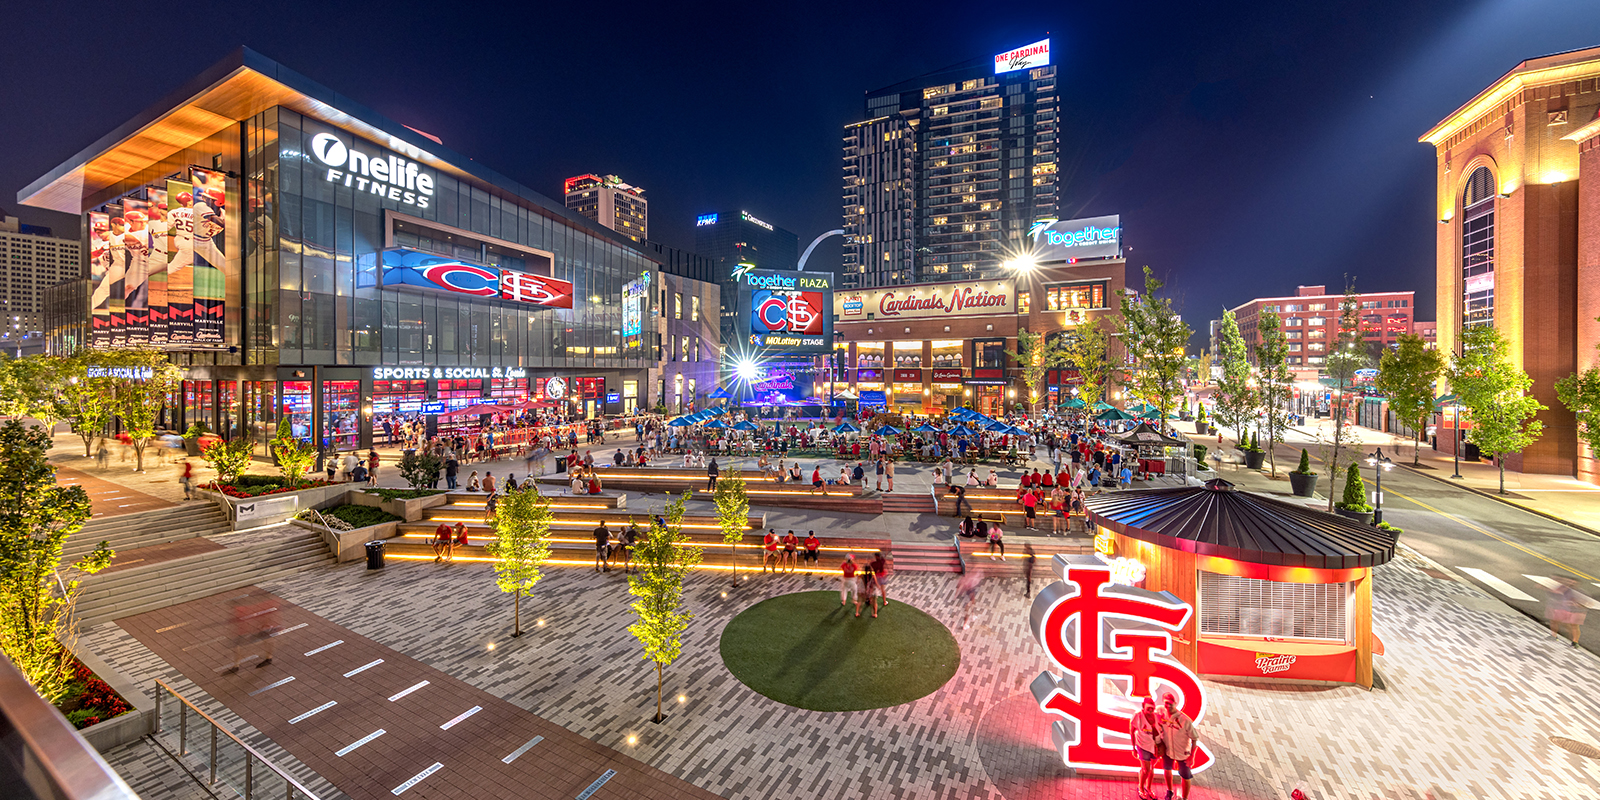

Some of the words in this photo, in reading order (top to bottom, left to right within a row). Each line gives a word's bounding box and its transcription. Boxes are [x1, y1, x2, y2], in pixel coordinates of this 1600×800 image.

[995, 53, 1008, 63] ONE
[1010, 45, 1049, 60] CARDINAL
[326, 168, 429, 209] FITNESS
[696, 217, 716, 227] KPMG
[1044, 226, 1119, 248] Together
[745, 272, 797, 289] Together
[800, 277, 829, 289] PLAZA
[879, 292, 946, 316] Cardinals
[944, 286, 1007, 313] Nation
[802, 338, 824, 346] STAGE
[372, 367, 431, 380] SPORTS
[433, 368, 443, 379] &
[445, 368, 490, 379] SOCIAL
[504, 366, 526, 380] Louis
[754, 380, 794, 392] Cardinals
[1254, 654, 1297, 668] Prairie
[1261, 664, 1290, 675] Farms
